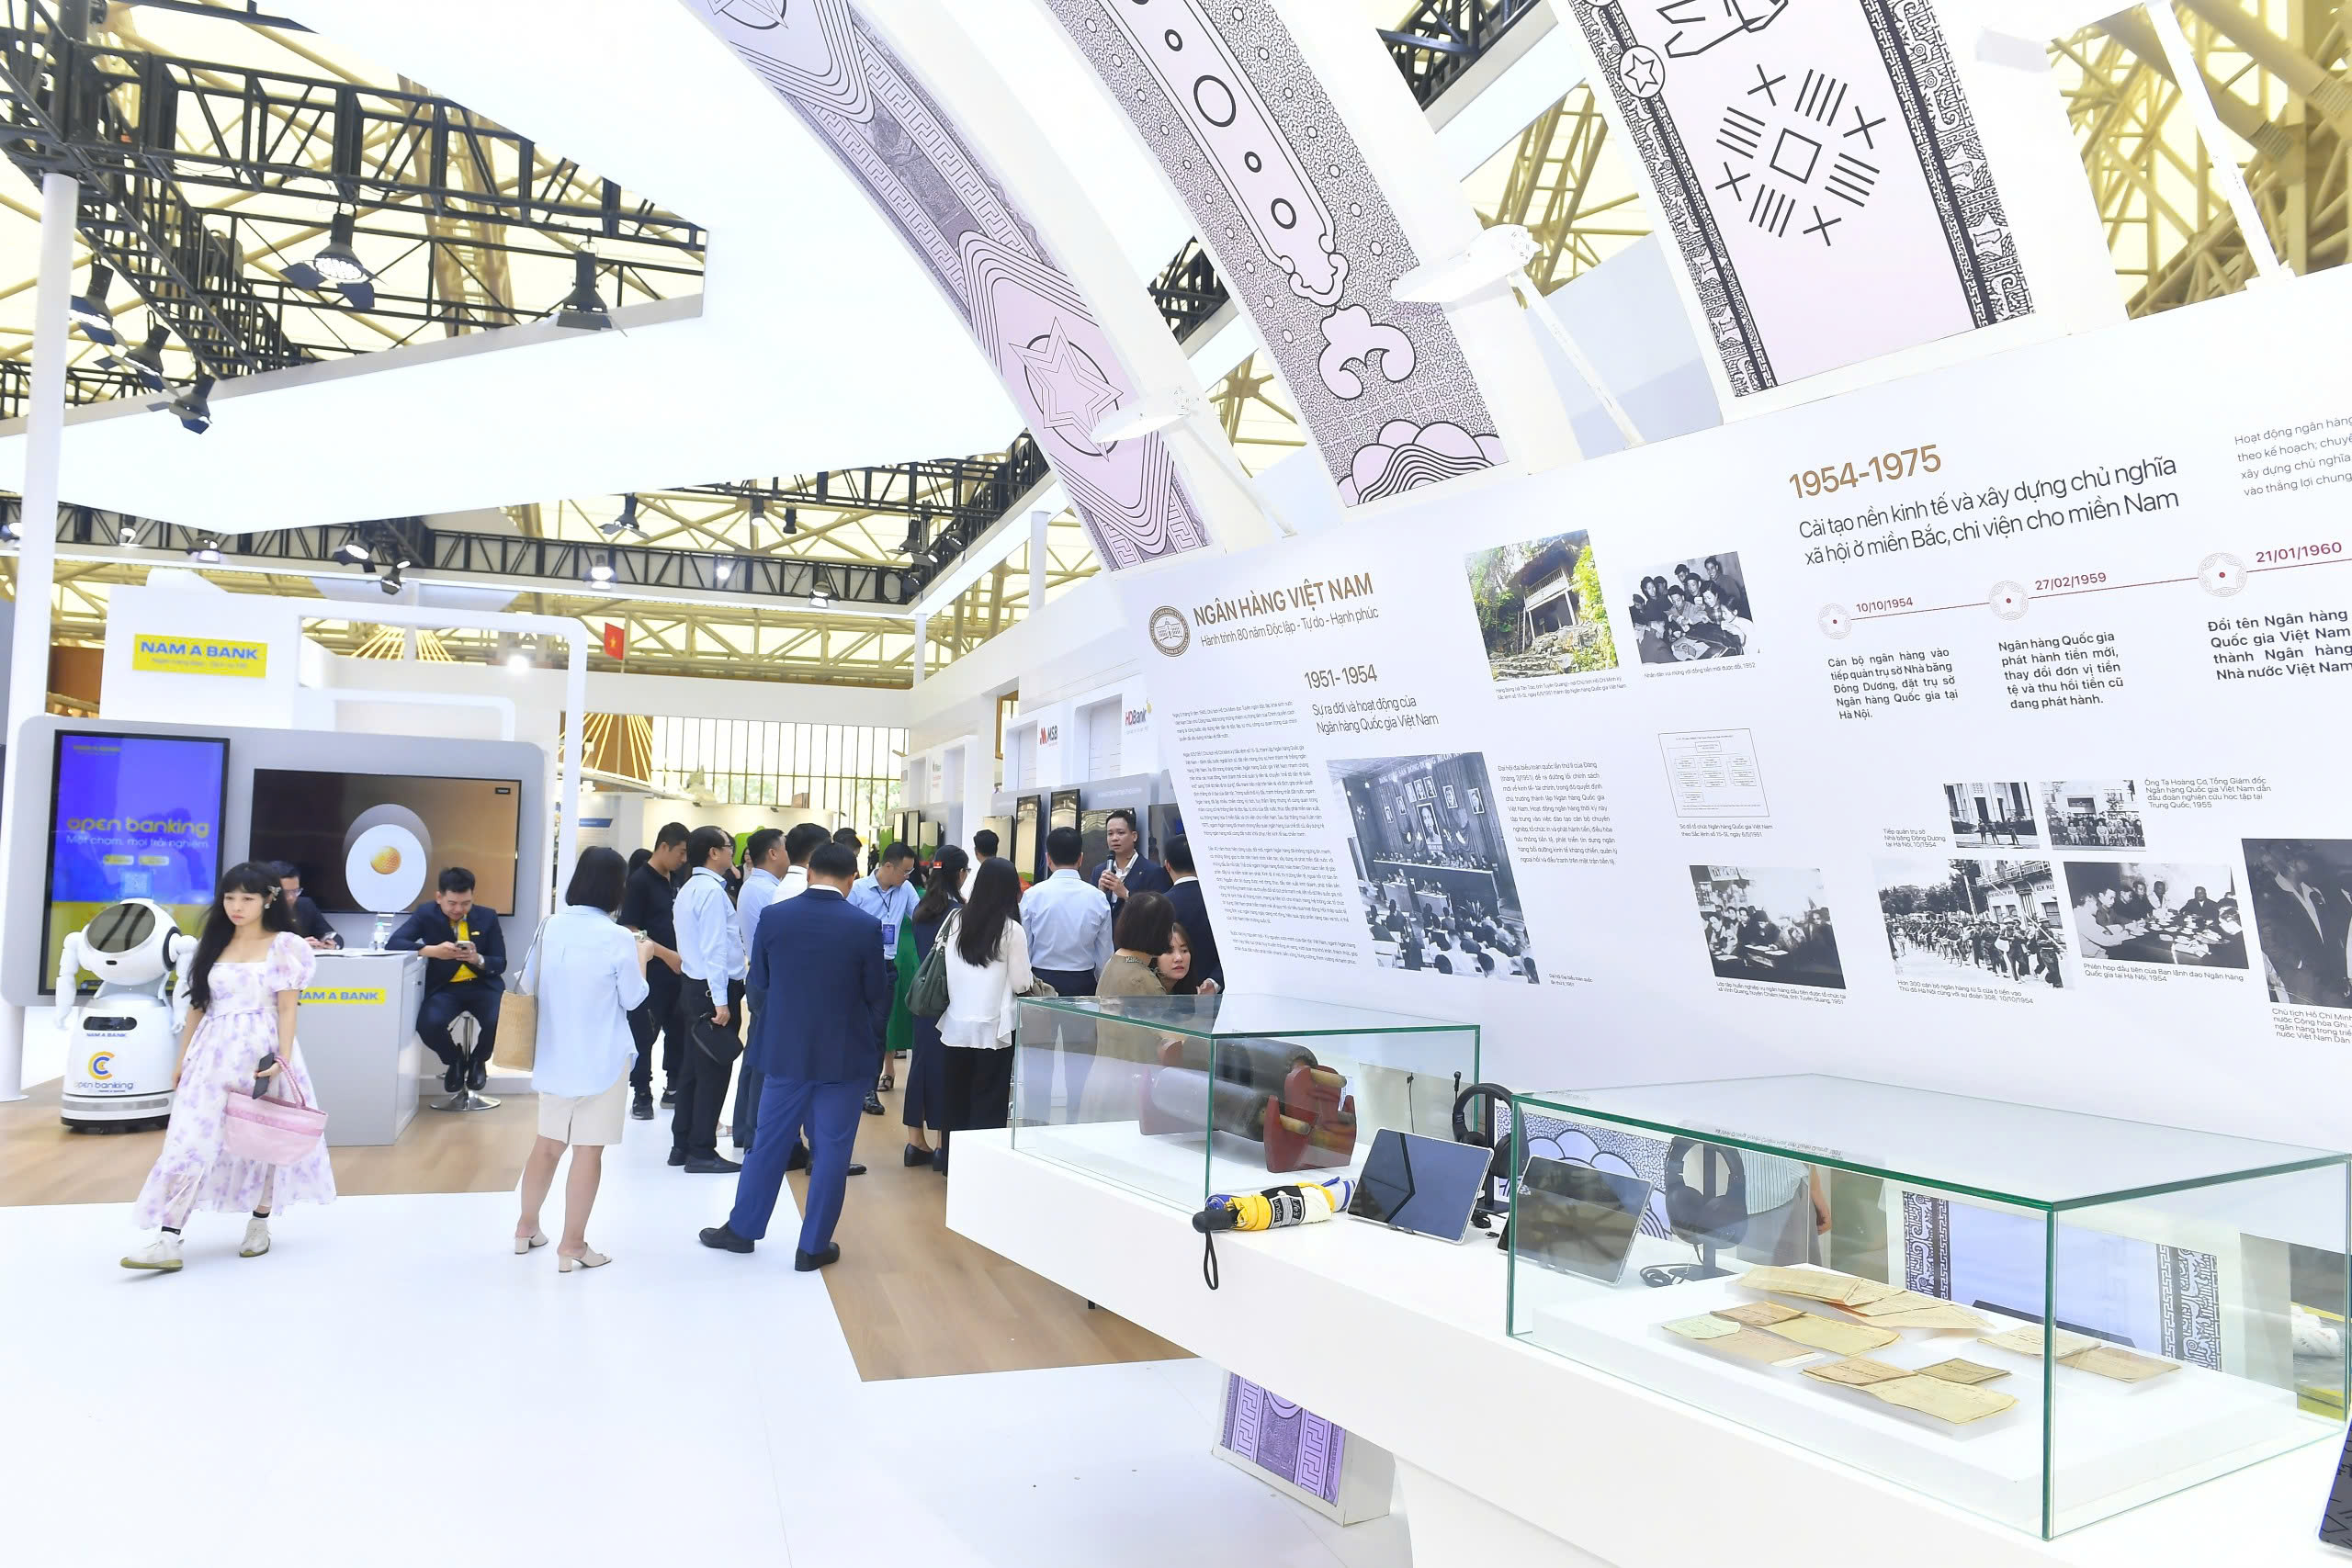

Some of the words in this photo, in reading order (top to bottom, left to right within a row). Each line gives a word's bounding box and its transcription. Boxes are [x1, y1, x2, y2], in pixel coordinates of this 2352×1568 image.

[2234, 433, 2261, 445] Hoạt
[2263, 428, 2292, 440] động
[2294, 422, 2324, 434] ngân
[2237, 451, 2262, 462] theo
[2264, 445, 2277, 457] kế
[2278, 441, 2317, 455] hoạch;
[1790, 444, 1940, 498] 1954-1975
[2241, 468, 2258, 479] xây
[2262, 465, 2291, 476] dựng
[2294, 458, 2315, 470] chủ
[2318, 453, 2350, 467] nghĩa
[2244, 487, 2263, 495] vào
[2266, 479, 2298, 492] thắng
[2300, 477, 2312, 489] lợi
[2315, 472, 2352, 484] chung
[1799, 518, 1826, 537] Cải
[1826, 517, 1854, 536] tạo
[1857, 505, 1892, 528] nền
[1890, 501, 1930, 524] kinh
[1929, 492, 1948, 515] tế
[1951, 491, 1973, 511] và
[1976, 487, 2008, 508] xây
[2014, 479, 2067, 502] dựng
[2071, 466, 2110, 491] chủ
[2114, 456, 2177, 485] nghĩa
[1804, 547, 1824, 565] xã
[1825, 542, 1850, 563] hội
[1867, 531, 1909, 555] miền
[1911, 524, 1950, 547] Bắc,
[1952, 520, 1980, 541] chi
[1983, 515, 2023, 538] viện
[2027, 509, 2064, 529] cho
[2068, 498, 2120, 523] miền
[2123, 492, 2178, 514] Nam
[2256, 542, 2342, 563] 21/01/1960
[2035, 572, 2106, 591] 27/02/1959
[1193, 597, 1238, 626] NGÂN
[1238, 590, 1285, 617] HÀNG
[1286, 578, 1324, 611] VIỆT
[1328, 572, 1373, 601] NAM
[1856, 597, 1913, 613] 10/10/1954
[1200, 634, 1220, 647] Hành
[1219, 630, 1237, 643] trình
[1237, 627, 1248, 640] 80
[1249, 626, 1266, 638] năm
[1265, 622, 1283, 637] Độc
[1282, 620, 1295, 636] lập
[1300, 617, 1312, 632] Tự
[1313, 615, 1324, 627] do
[1329, 610, 1354, 626] Hạnh
[1354, 606, 1378, 624] phúc
[2235, 617, 2259, 630] tên
[2264, 613, 2303, 627] Ngân
[2309, 610, 2347, 622] hàng
[1998, 639, 2029, 652] Ngân
[2030, 637, 2060, 649] hàng
[2062, 633, 2094, 649] Quốc
[2096, 631, 2114, 644] gia
[2211, 633, 2247, 648] Quốc
[2253, 632, 2275, 646] gia
[2279, 629, 2310, 643] Việt
[2315, 627, 2350, 638] Nam
[141, 641, 186, 655] NAM
[190, 645, 202, 656] A
[206, 646, 258, 660] BANK
[1827, 658, 1847, 668] Cán
[1851, 655, 1864, 666] bộ
[1869, 653, 1894, 664] ngân
[1898, 650, 1925, 660] hàng
[1930, 648, 1949, 658] vào
[2001, 654, 2027, 668] phát
[2030, 652, 2060, 666] hành
[2064, 649, 2087, 660] tiền
[2092, 646, 2118, 661] mới,
[2213, 651, 2254, 663] thành
[2264, 647, 2303, 660] Ngân
[2314, 644, 2352, 656] hàng
[1830, 669, 1849, 681] tiếp
[1874, 669, 1889, 678] trụ
[1904, 663, 1924, 673] Nhà
[1925, 662, 1952, 672] băng
[2004, 671, 2029, 681] thay
[2055, 666, 2078, 676] đơn
[2082, 663, 2093, 676] vị
[2097, 660, 2120, 672] tiền
[2216, 668, 2245, 680] Nhà
[2247, 665, 2283, 678] nước
[2286, 663, 2315, 676] Việt
[2319, 661, 2352, 672] Nam
[1833, 683, 1859, 694] Đông
[1862, 682, 1897, 691] Dương,
[1902, 678, 1918, 691] đặt
[1922, 678, 1938, 688] trụ
[2007, 684, 2018, 696] tệ
[2021, 683, 2034, 693] và
[2038, 682, 2057, 692] thu
[2060, 679, 2078, 691] hồi
[2081, 677, 2105, 689] tiền
[2108, 677, 2123, 687] cũ
[1312, 704, 1324, 717] Sự
[1324, 705, 1332, 715] ra
[1332, 702, 1346, 714] đời
[1345, 700, 1356, 712] và
[1355, 699, 1375, 716] hoạt
[1375, 697, 1399, 712] động
[1399, 694, 1417, 707] của
[1836, 696, 1861, 707] Ngân
[1864, 694, 1890, 705] hàng
[1894, 693, 1920, 702] Quốc
[1925, 691, 1940, 702] gia
[1944, 689, 1958, 700] tại
[2010, 699, 2039, 709] đang
[2041, 696, 2067, 708] phát
[2069, 694, 2103, 705] hành.
[1125, 708, 1147, 726] HDBank
[1316, 720, 1339, 735] Ngân
[1338, 719, 1360, 733] hàng
[1360, 716, 1384, 730] Quốc
[1384, 716, 1397, 730] gia
[1396, 715, 1416, 729] Việt
[1415, 714, 1439, 726] Nam
[1838, 710, 1852, 719] Hà
[1853, 708, 1872, 720] Nội.
[1047, 725, 1058, 741] MSB
[2144, 778, 2159, 787] Ông
[2251, 775, 2266, 785] đốc
[67, 818, 121, 833] open
[126, 817, 209, 838] banking
[328, 992, 337, 1000] A
[340, 991, 379, 1000] BANK
[1273, 1199, 1282, 1222] under
